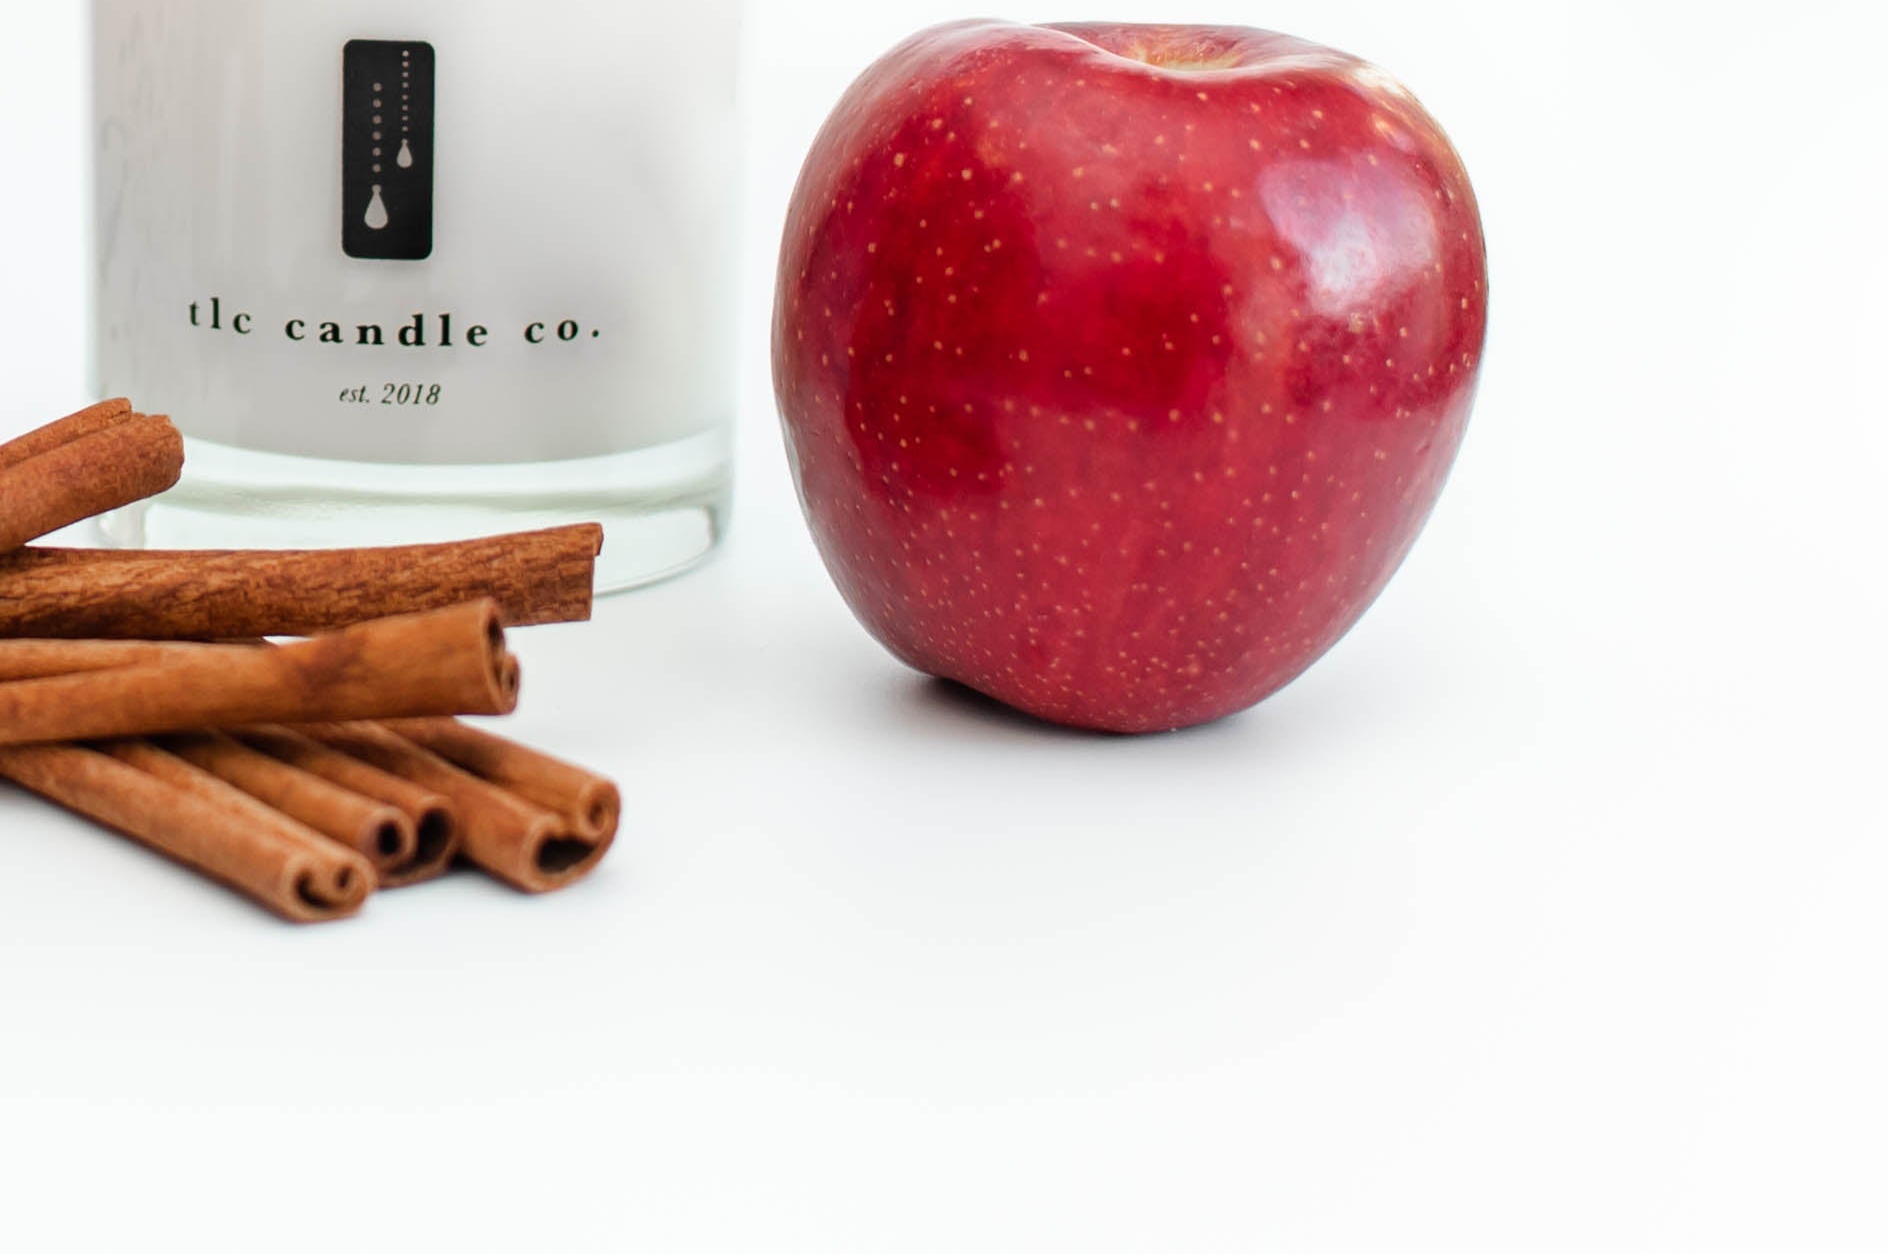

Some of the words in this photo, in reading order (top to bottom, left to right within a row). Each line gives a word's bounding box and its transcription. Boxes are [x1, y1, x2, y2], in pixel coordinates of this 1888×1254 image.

[189, 297, 253, 334] tlc
[284, 313, 489, 347] candle
[523, 319, 601, 344] co.
[339, 385, 371, 404] est.
[380, 383, 442, 406] 2018
